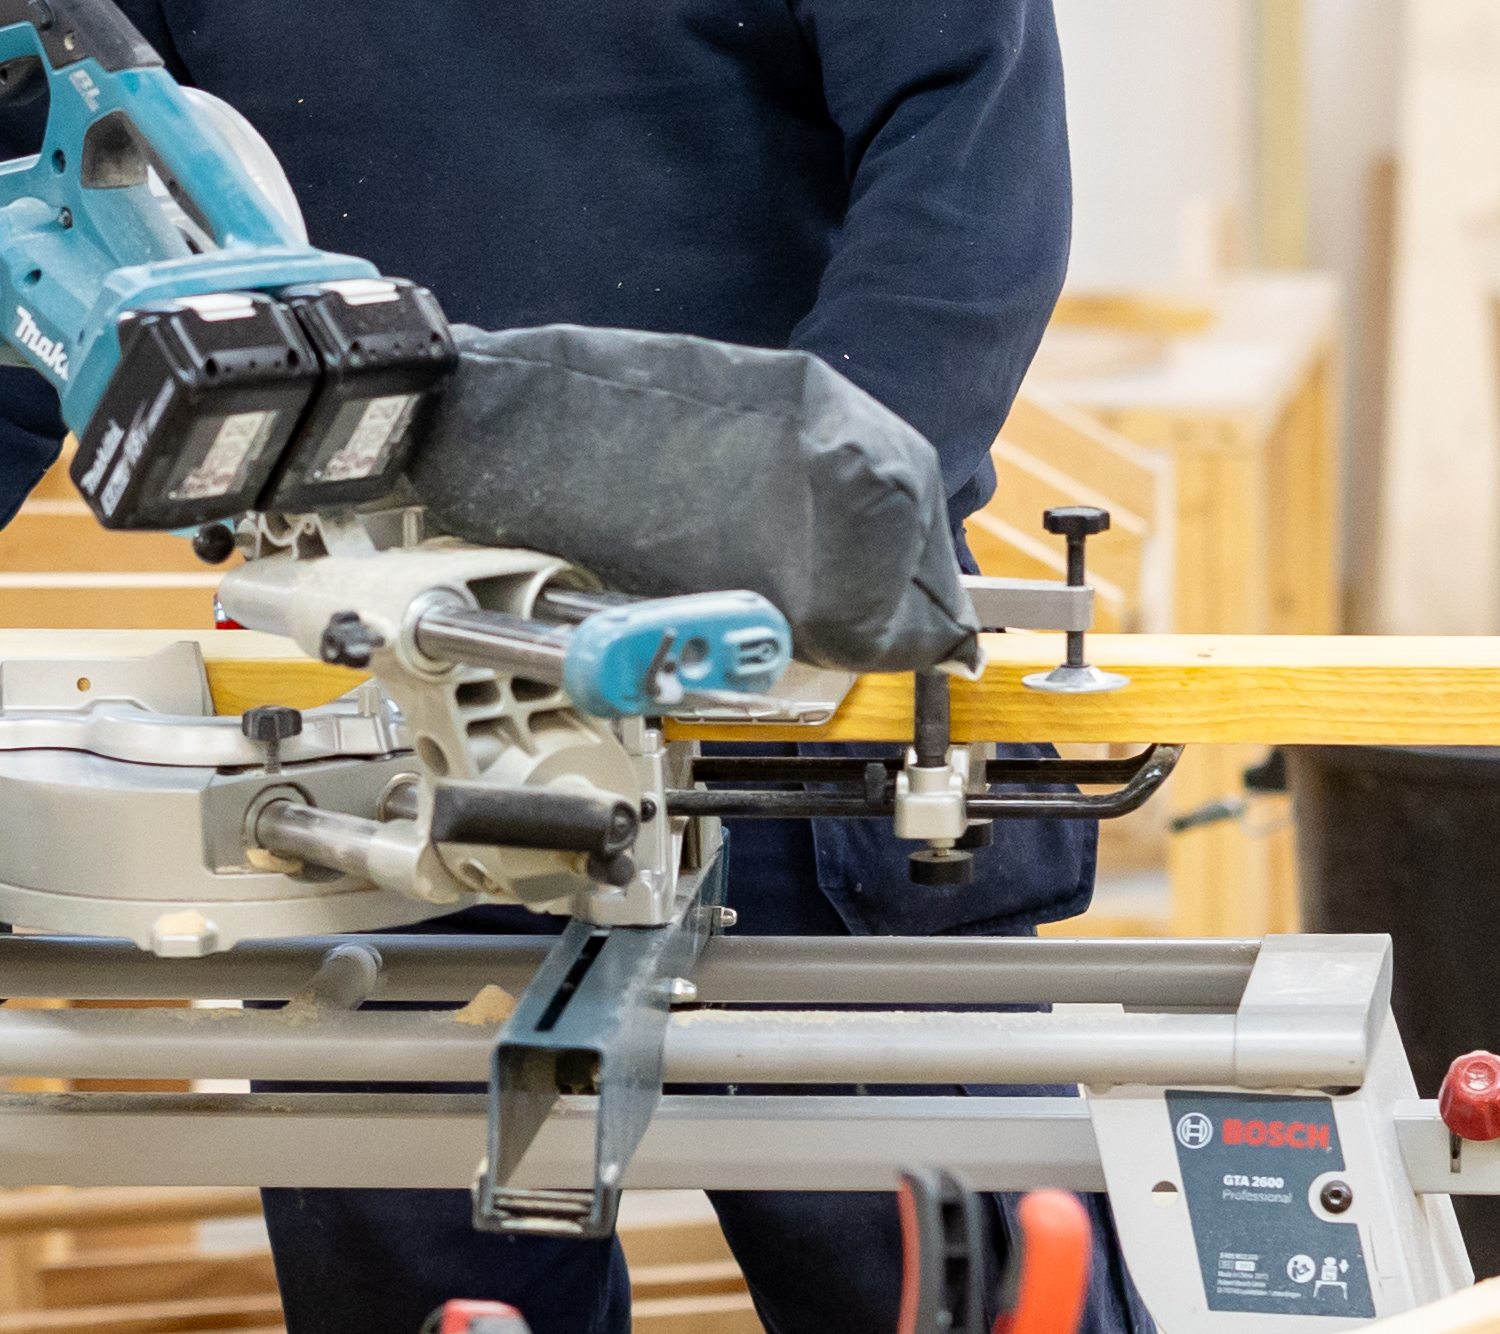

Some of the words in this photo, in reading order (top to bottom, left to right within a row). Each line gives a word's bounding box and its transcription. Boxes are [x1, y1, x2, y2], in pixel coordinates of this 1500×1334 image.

[1222, 1119, 1329, 1148] BOSCH
[1223, 1174, 1249, 1186] GTA
[1252, 1176, 1284, 1188] 2600
[1222, 1189, 1292, 1203] Professional
